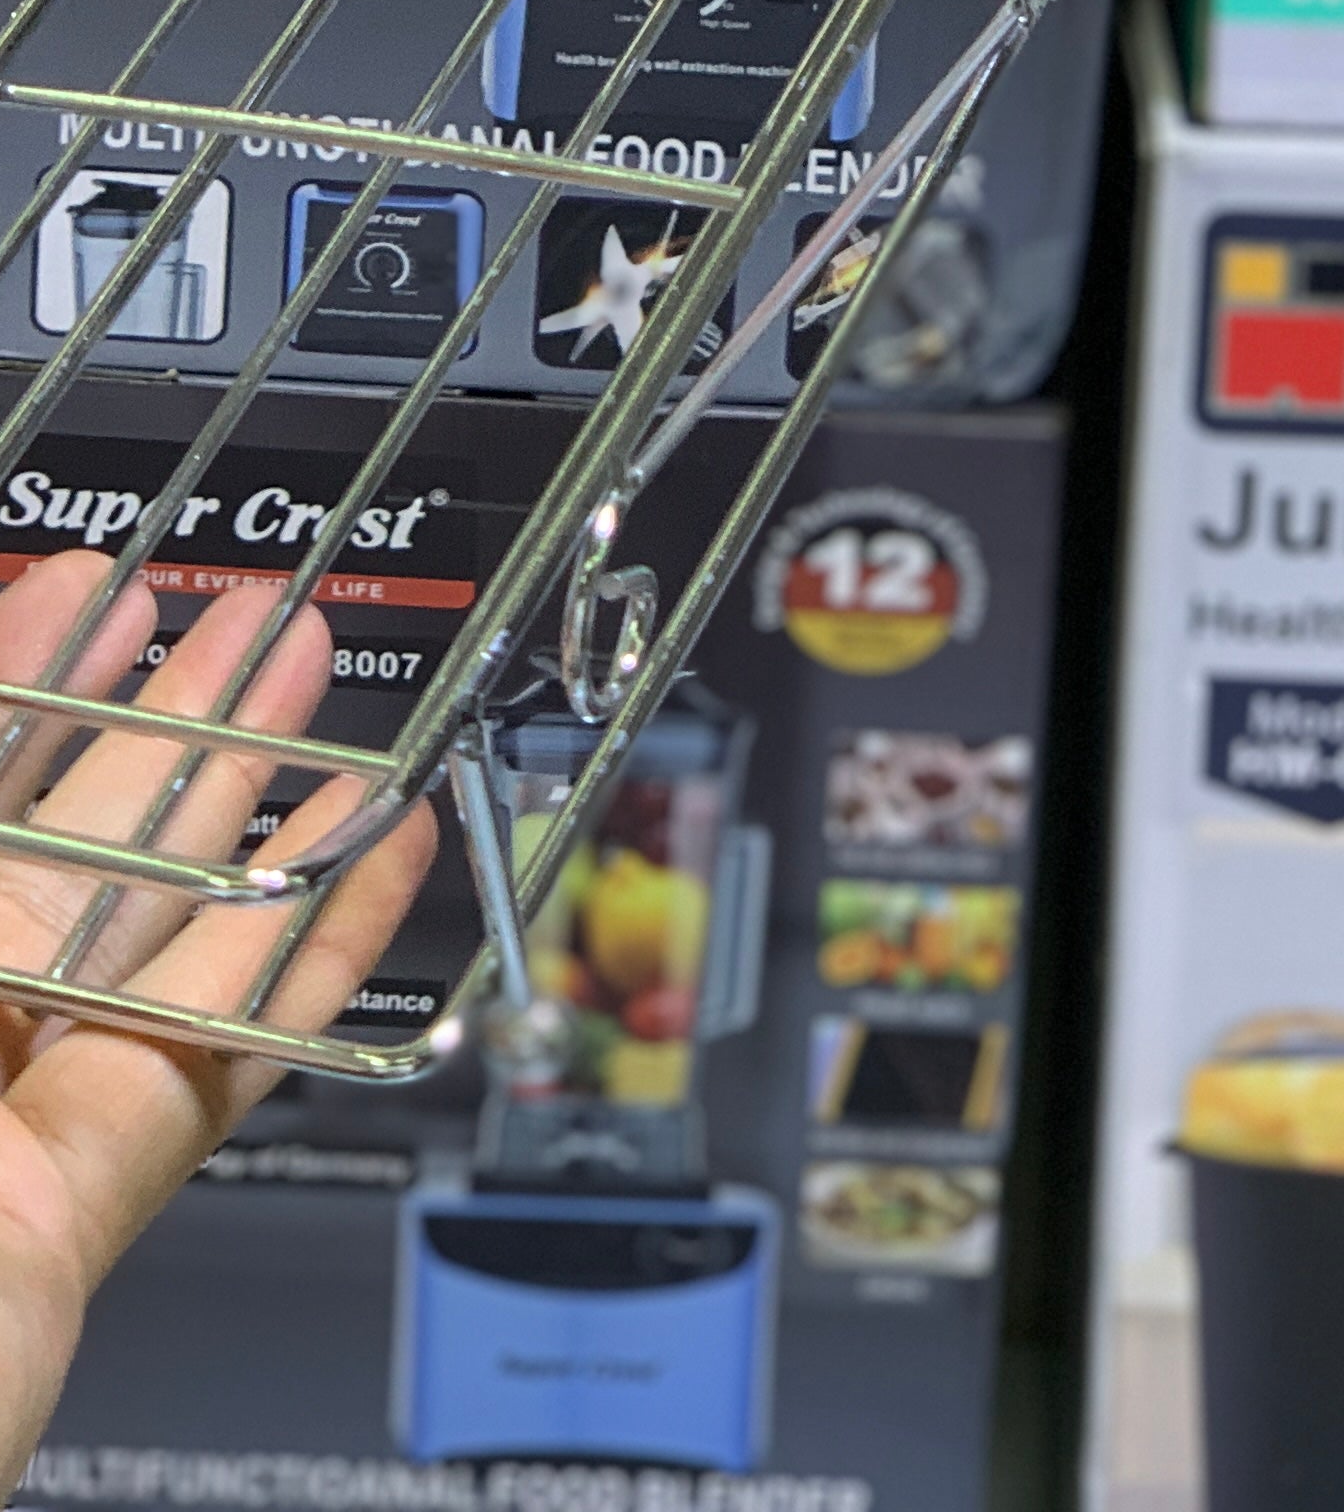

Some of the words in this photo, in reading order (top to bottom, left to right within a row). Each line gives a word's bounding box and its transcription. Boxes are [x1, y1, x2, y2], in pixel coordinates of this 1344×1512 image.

[746, 65, 795, 78] machin
[584, 132, 728, 184] FOOD
[134, 567, 184, 589] OUR
[194, 571, 321, 596] EVERYD
[332, 582, 385, 599] LIFE
[805, 527, 937, 611] 12
[332, 650, 423, 680] 8007
[245, 812, 280, 838] att
[348, 991, 437, 1015] stance
